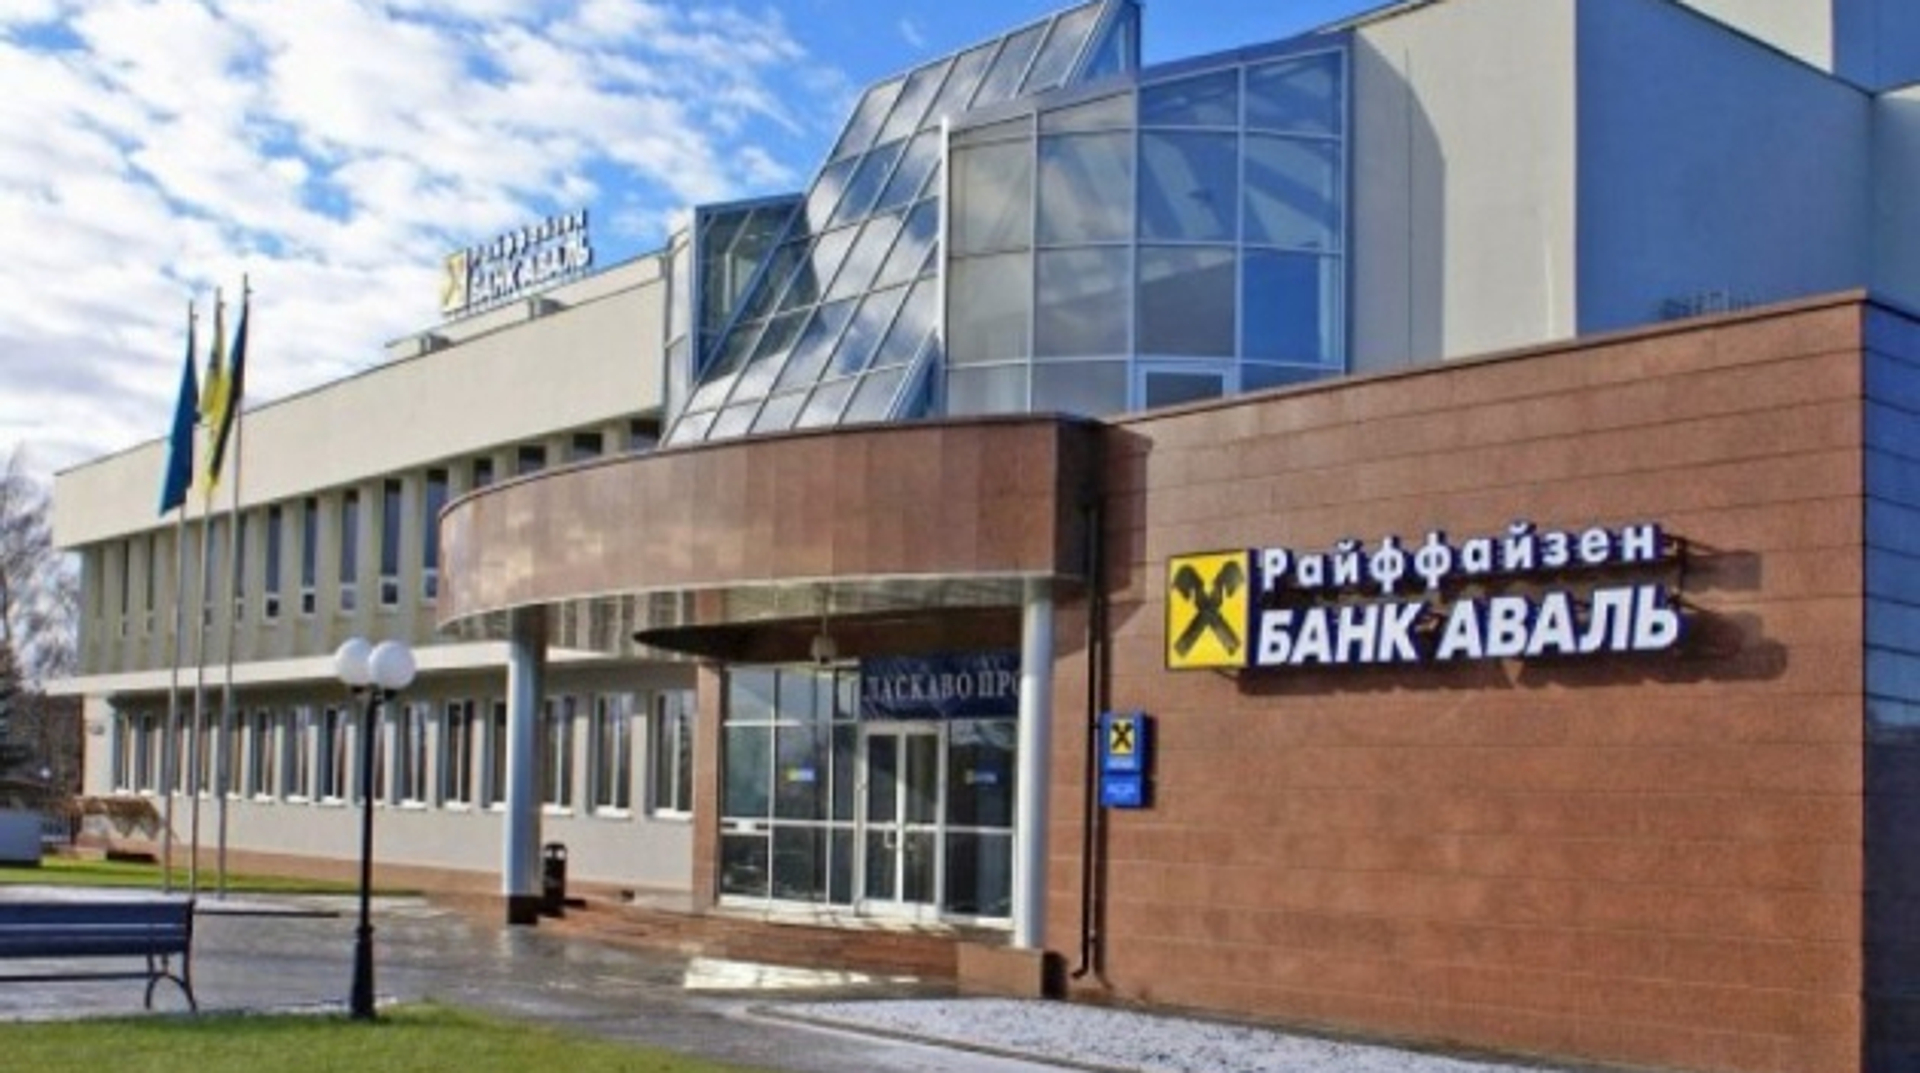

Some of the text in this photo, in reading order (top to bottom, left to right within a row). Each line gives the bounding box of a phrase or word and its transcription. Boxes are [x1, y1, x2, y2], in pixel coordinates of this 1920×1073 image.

[1262, 522, 1654, 593] Райффайзен
[1257, 585, 1679, 666] БАНК АВАЛЬ
